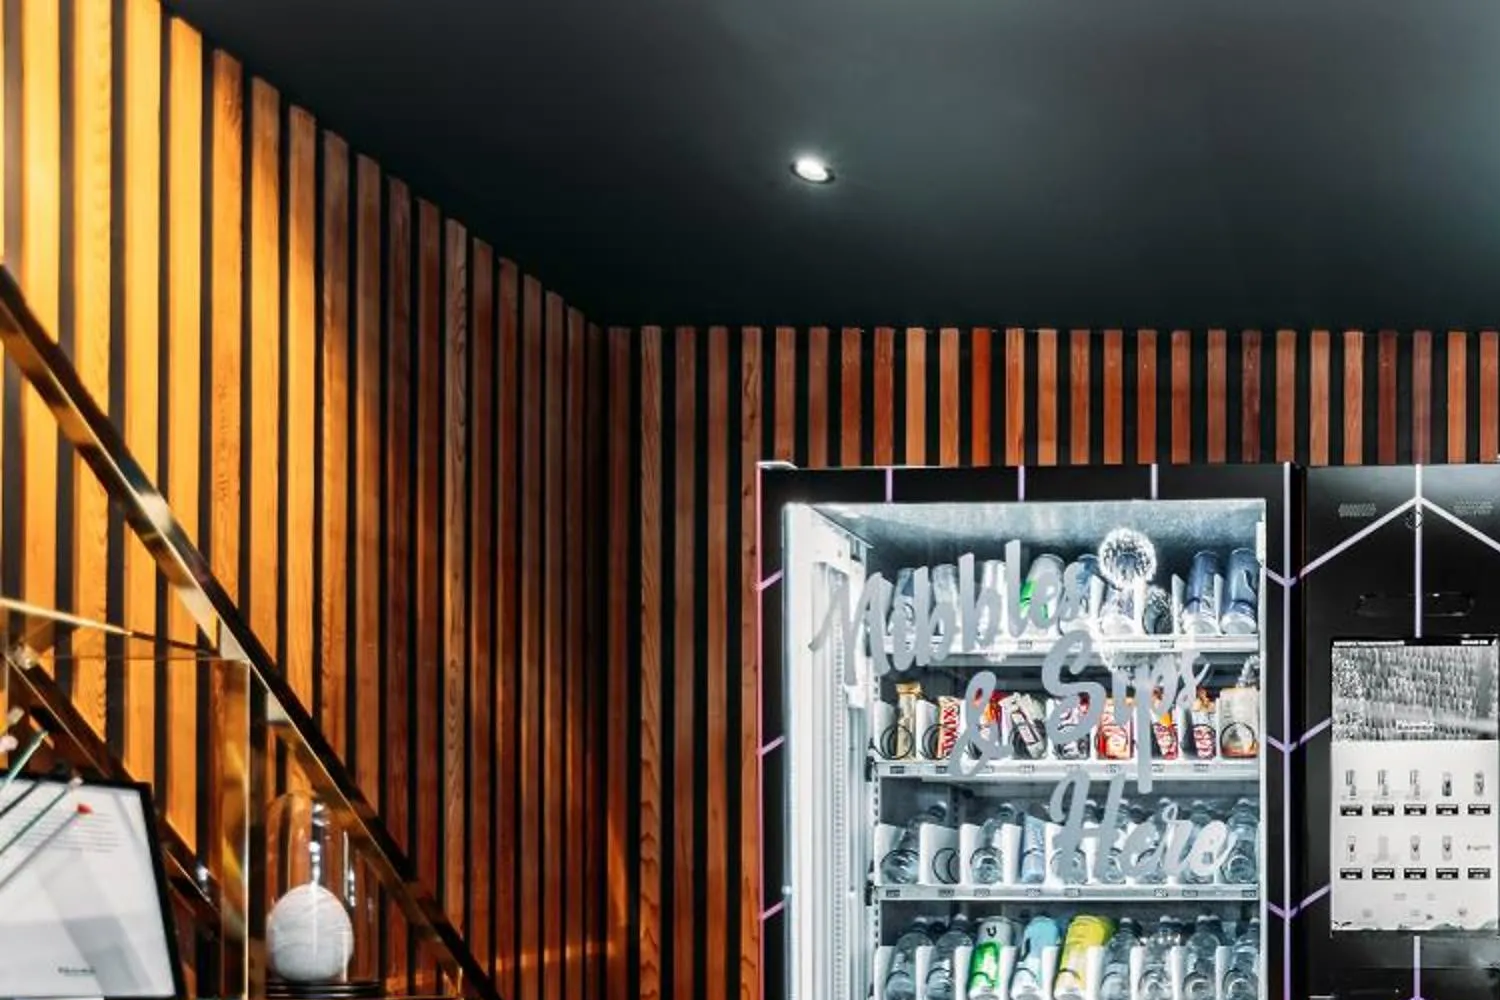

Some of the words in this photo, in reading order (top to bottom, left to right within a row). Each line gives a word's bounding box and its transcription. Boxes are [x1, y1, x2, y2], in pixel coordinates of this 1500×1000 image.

[807, 539, 1084, 686] Nibbles
[1040, 630, 1214, 795] Sips
[1049, 768, 1238, 880] Here
